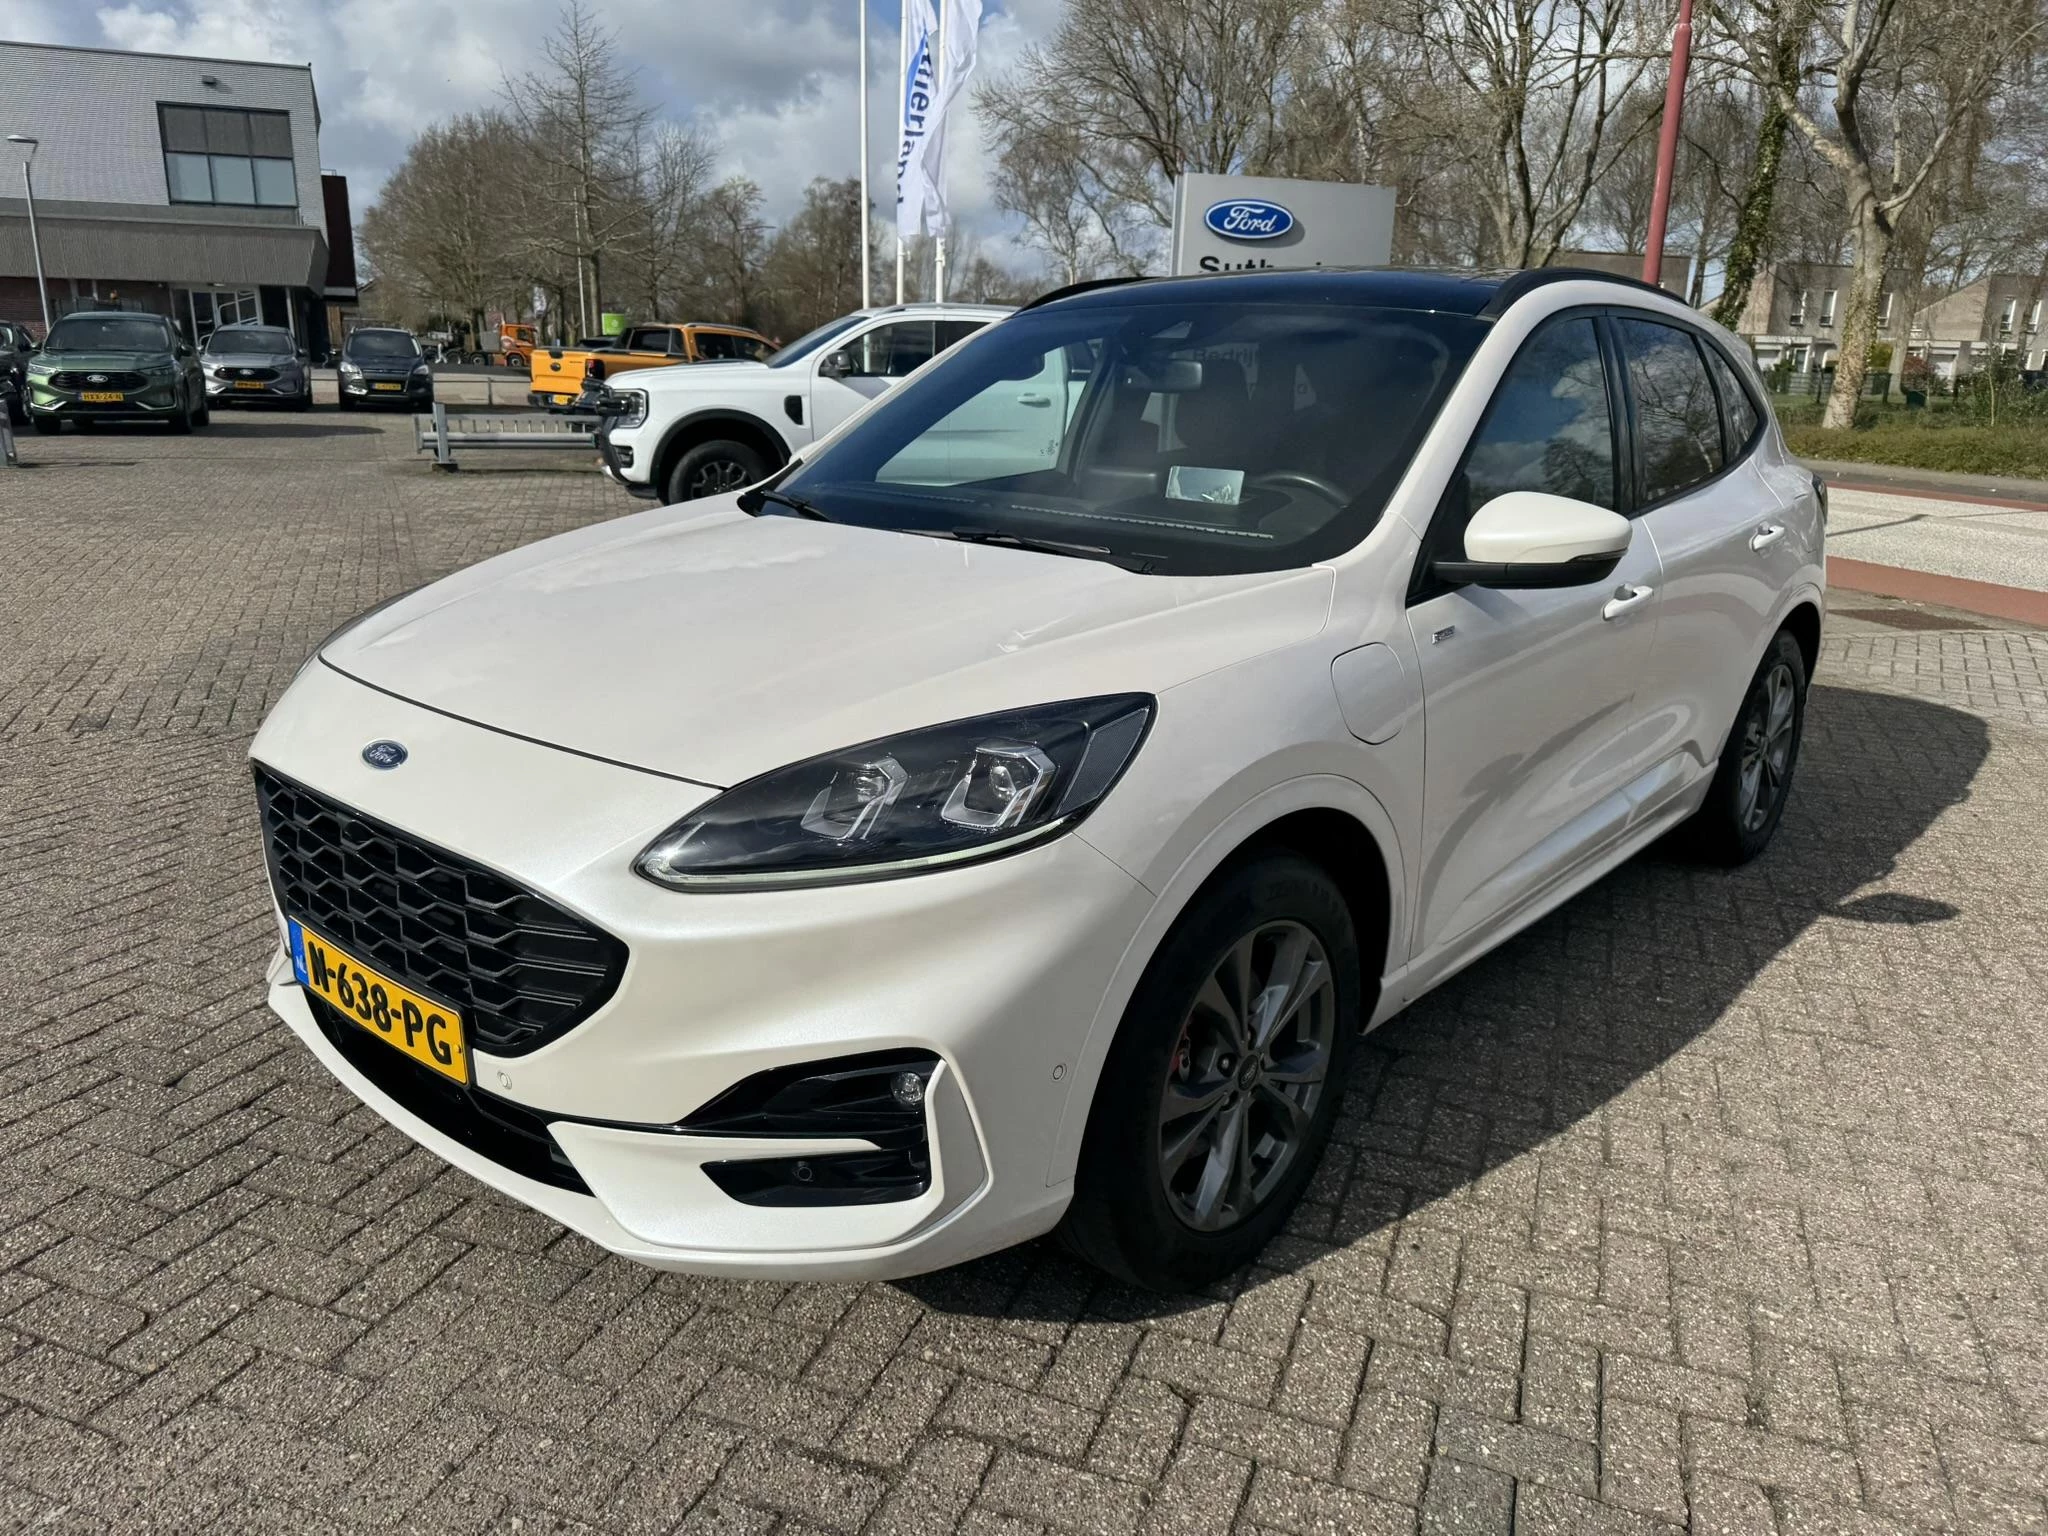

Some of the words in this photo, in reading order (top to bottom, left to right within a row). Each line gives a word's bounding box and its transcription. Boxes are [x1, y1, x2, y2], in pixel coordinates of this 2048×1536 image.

[1223, 205, 1278, 232] Ford
[369, 745, 397, 764] Ford
[308, 941, 452, 1066] N-638-PG
